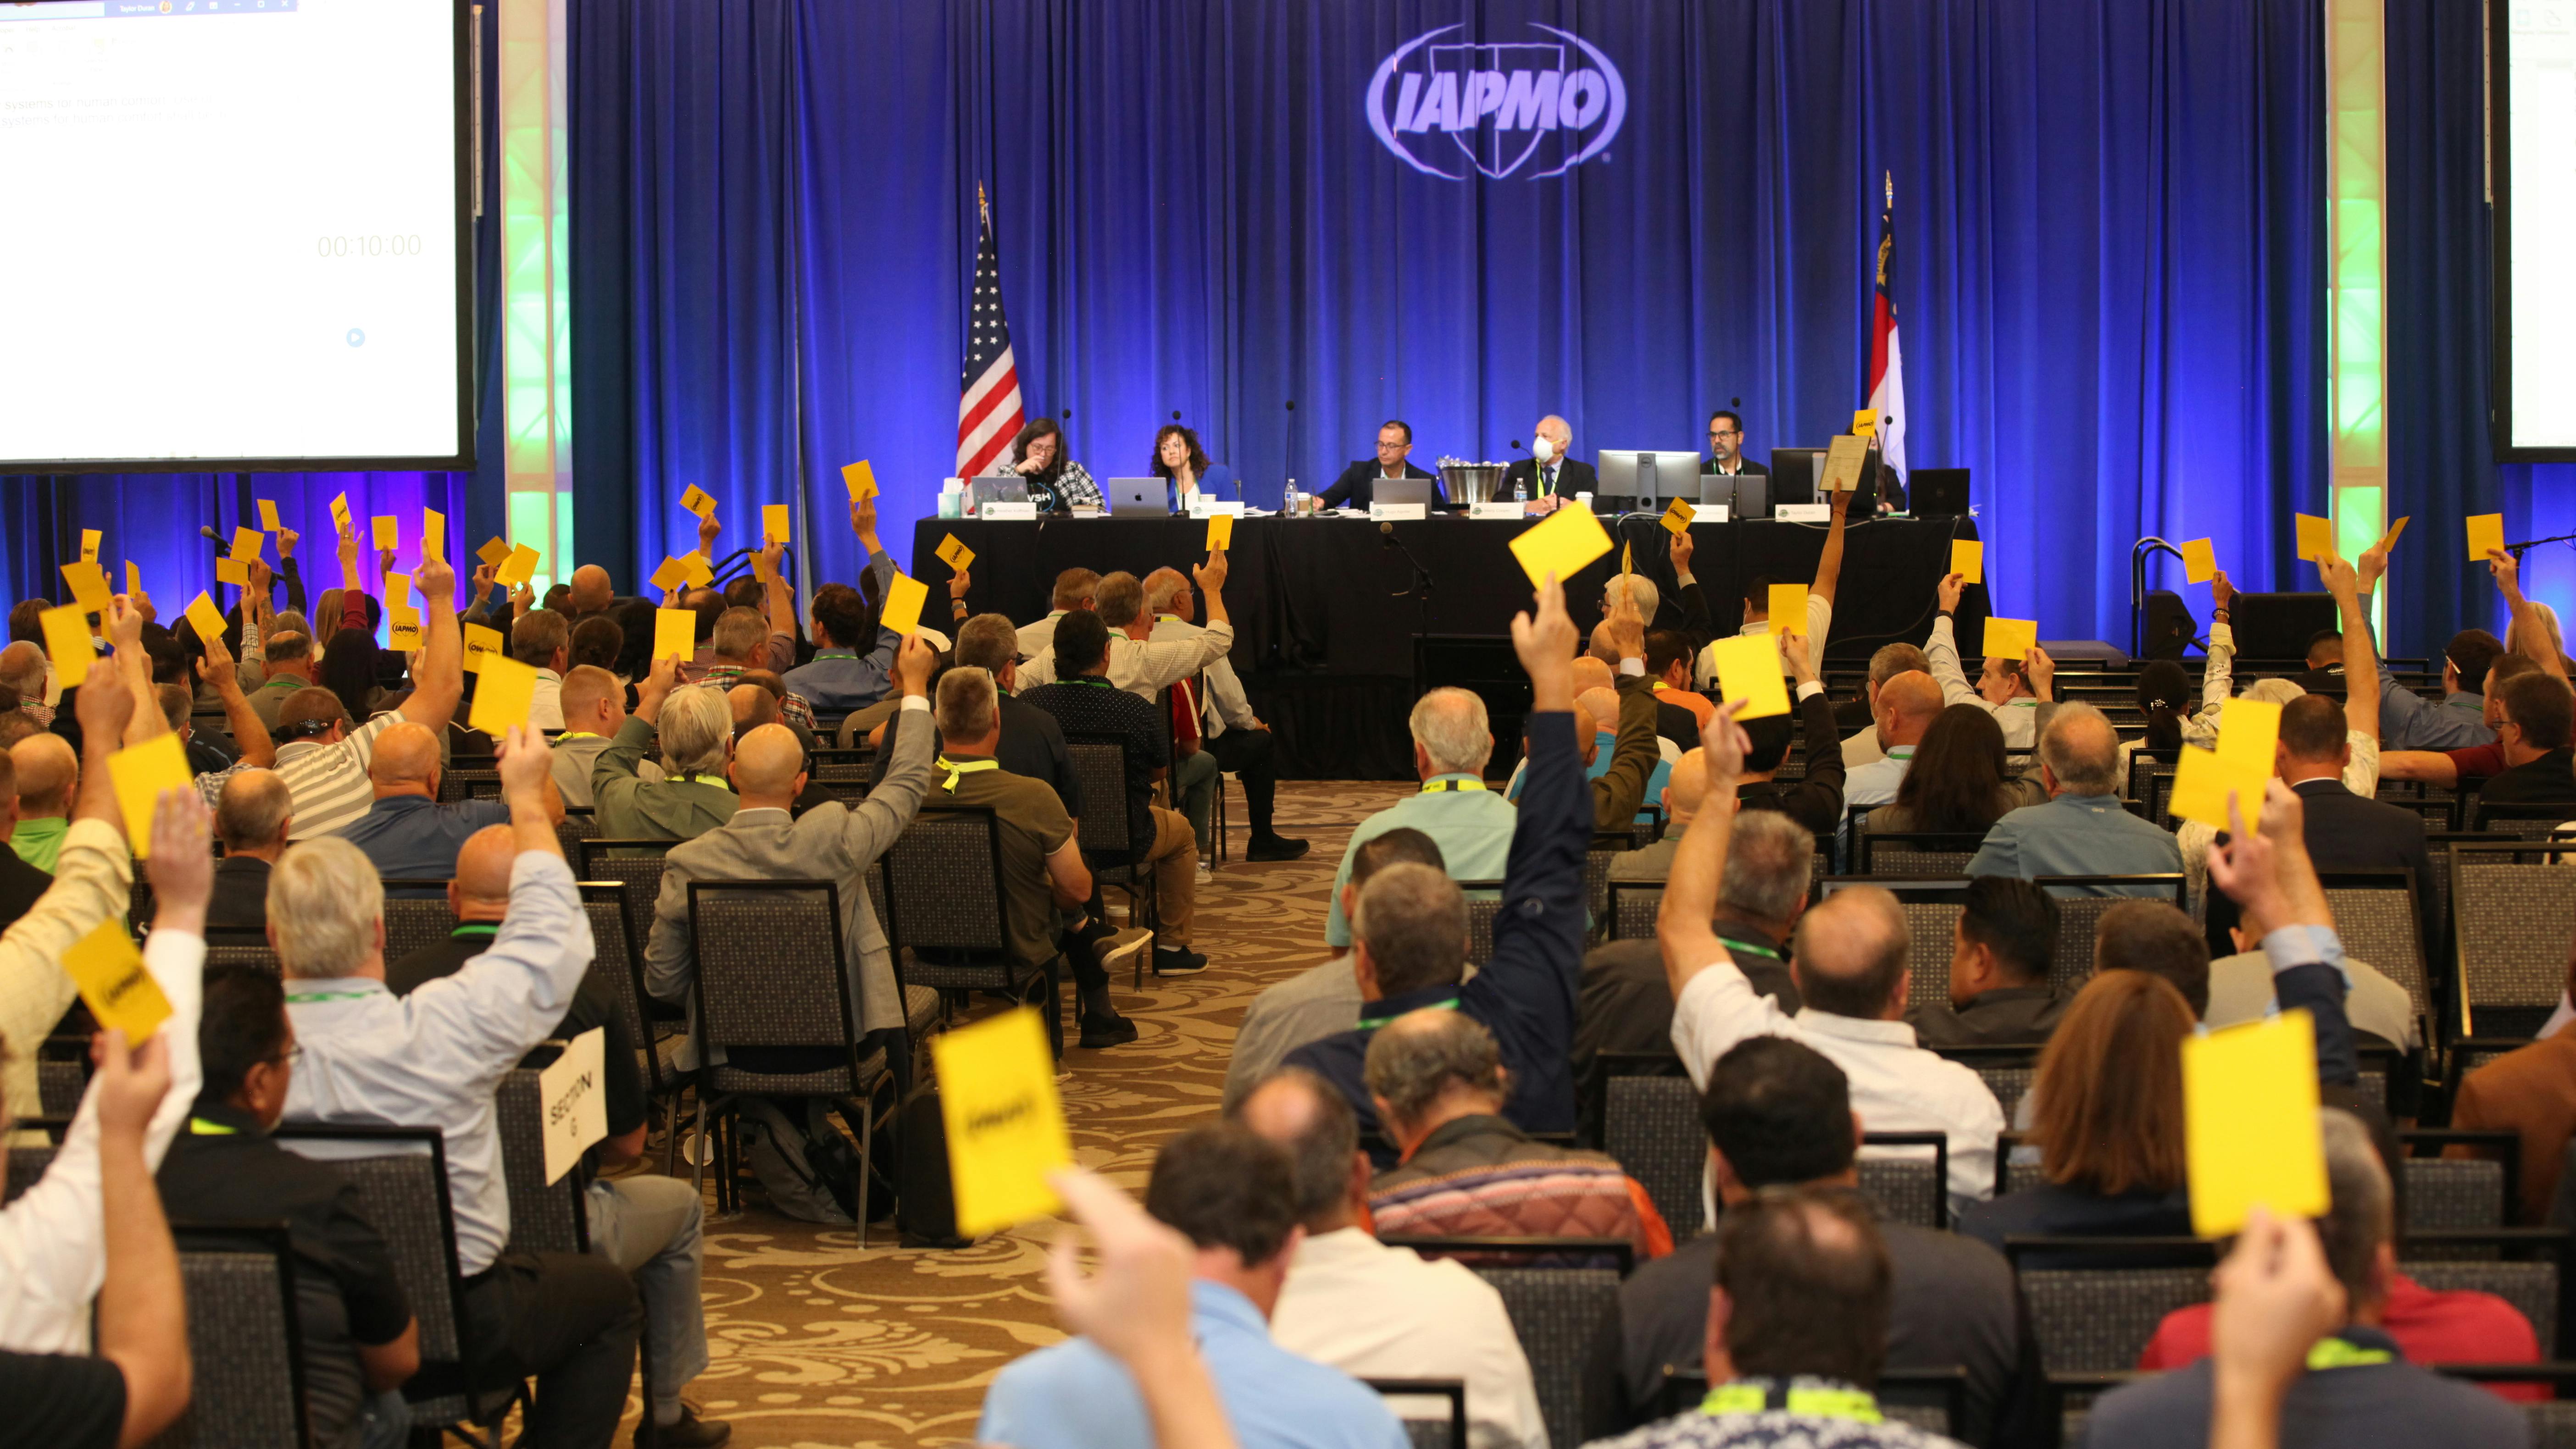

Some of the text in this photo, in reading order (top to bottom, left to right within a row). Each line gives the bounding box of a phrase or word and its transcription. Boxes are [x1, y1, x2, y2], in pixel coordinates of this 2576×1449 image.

[5, 99, 53, 111] systems
[1393, 68, 1607, 134] IAPMO
[1, 115, 50, 128] systems
[54, 113, 69, 124] for
[73, 113, 114, 124] human
[117, 111, 162, 124] comfort
[317, 234, 422, 258] 00:10:00
[952, 546, 962, 561] IAPMO
